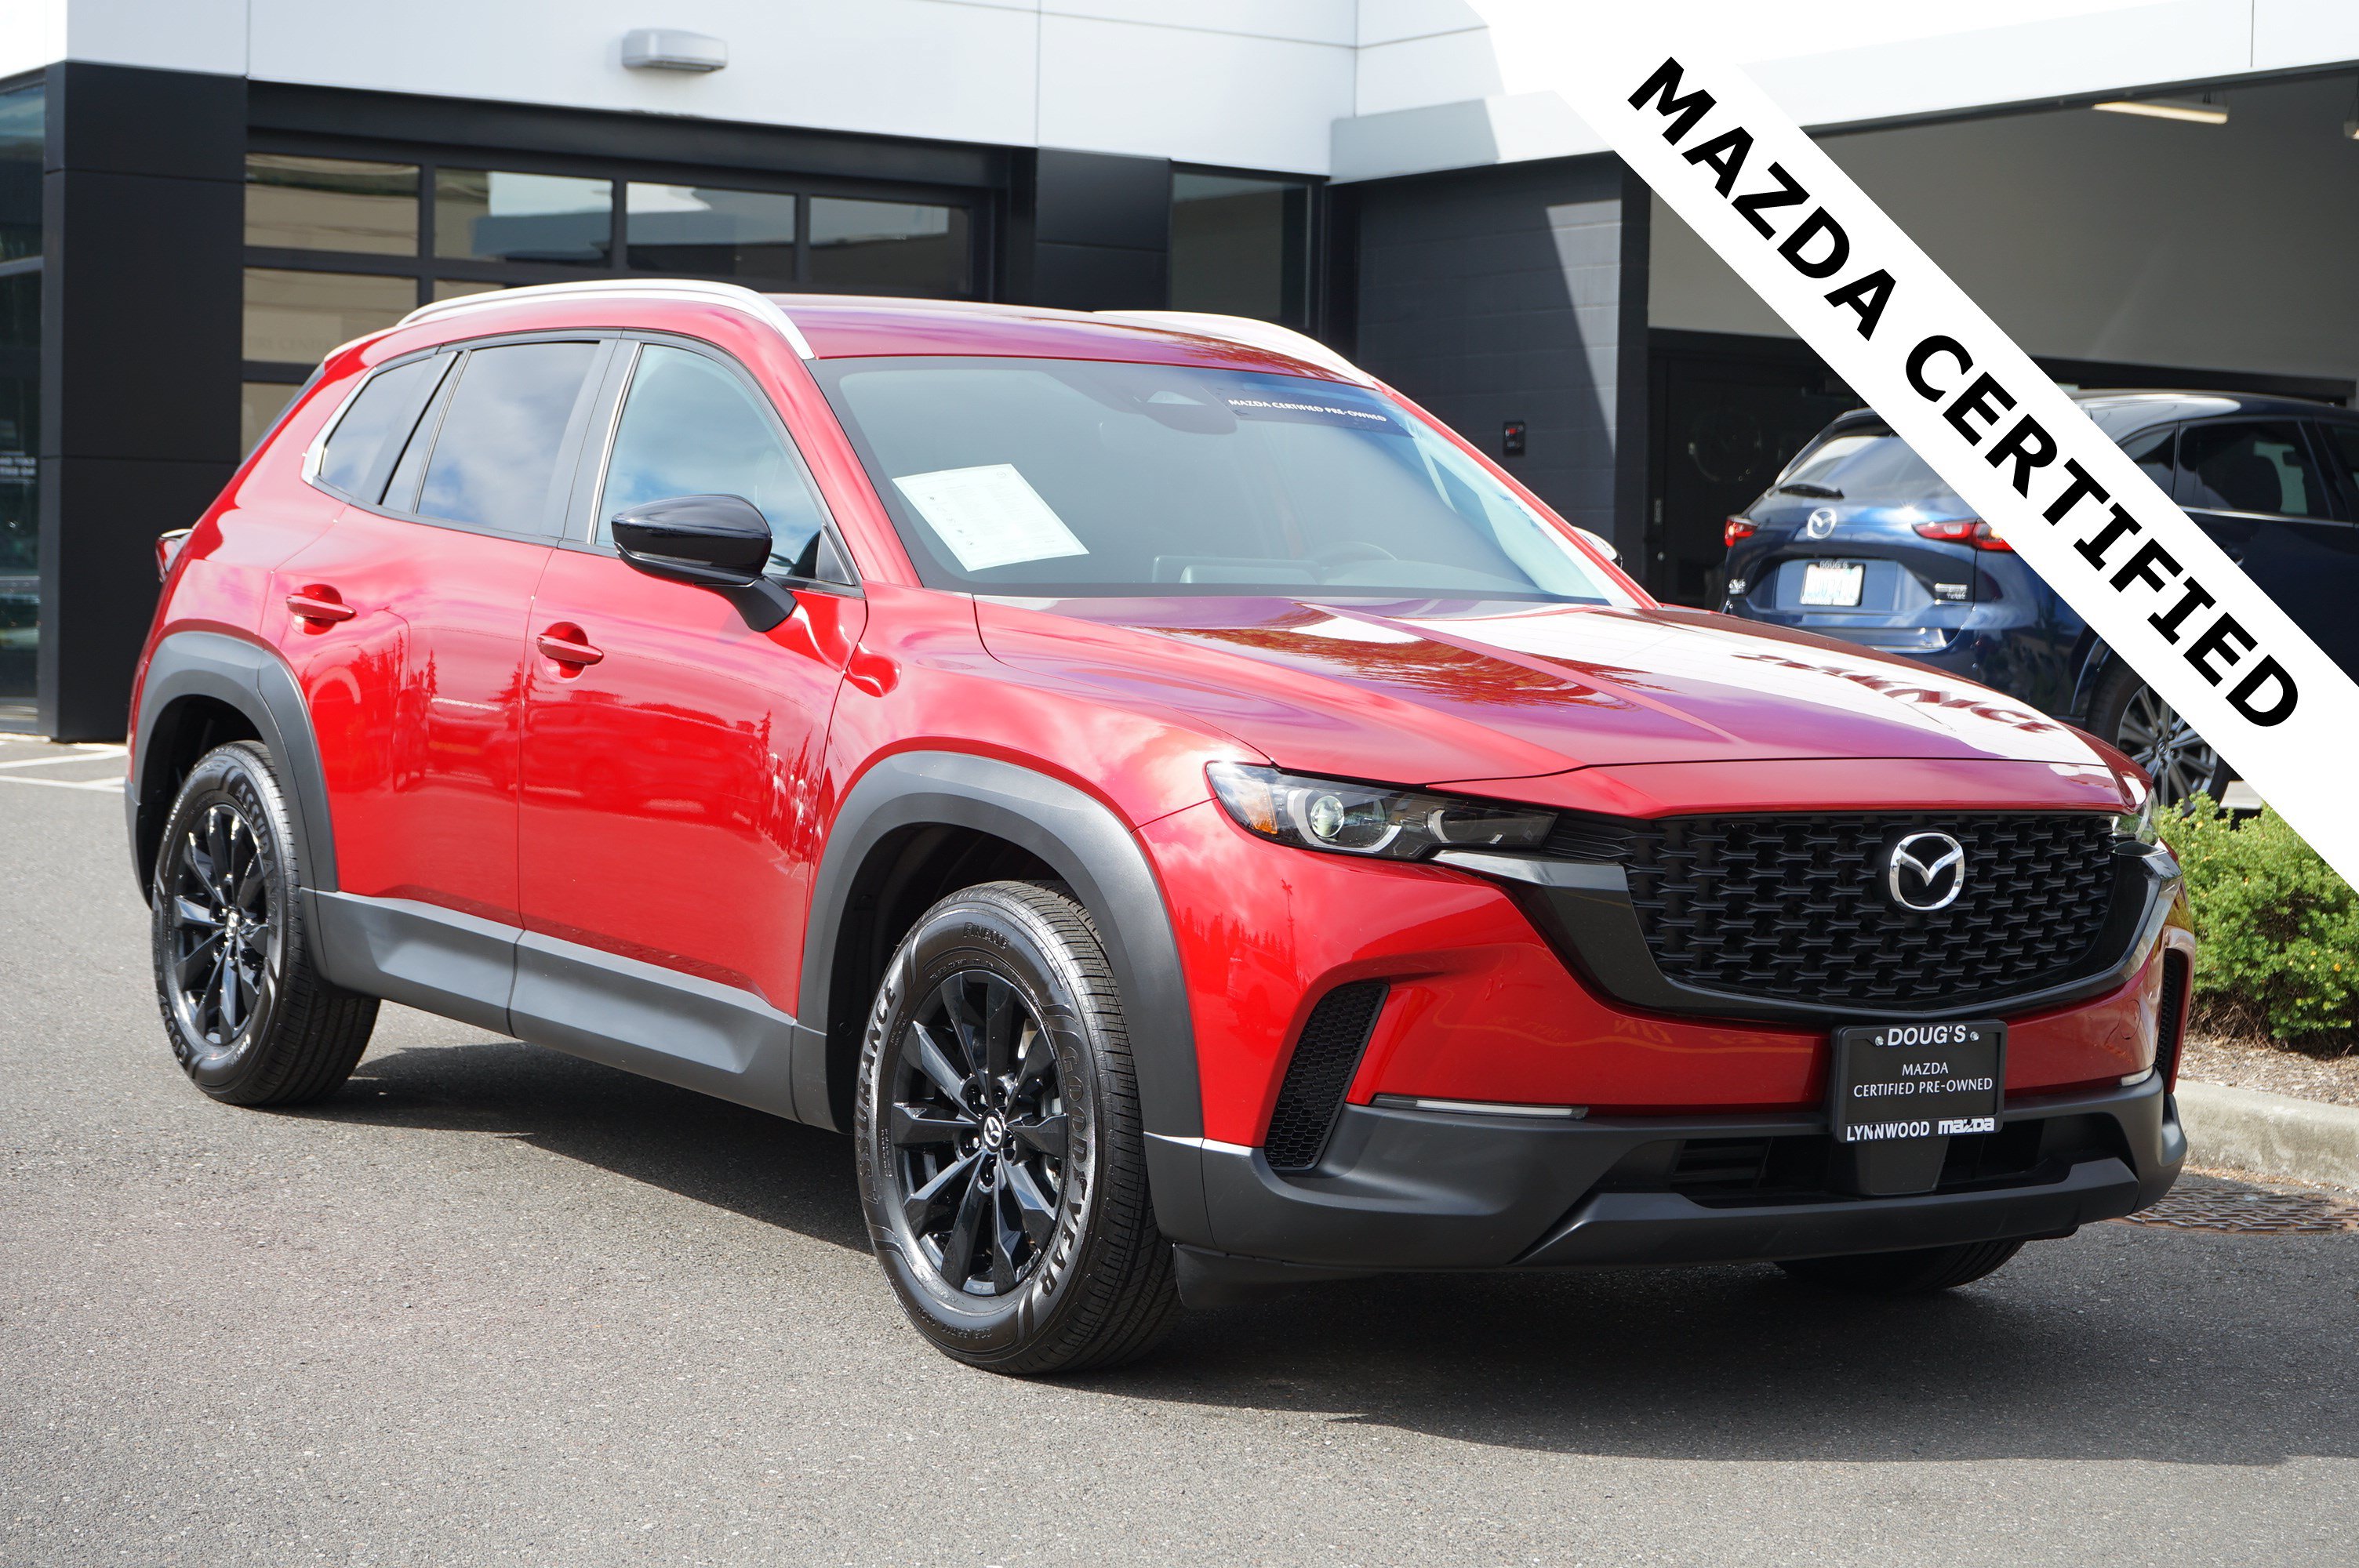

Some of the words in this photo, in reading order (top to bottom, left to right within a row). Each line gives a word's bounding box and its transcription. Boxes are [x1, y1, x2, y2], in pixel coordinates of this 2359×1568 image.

[1227, 398, 1271, 408] MAZDA
[1271, 401, 1324, 413] CERTIFIED
[1324, 406, 1387, 423] PRE-OWNED
[1887, 1025, 1967, 1047] DOUG'S
[1901, 1062, 1949, 1076] MAZDA
[854, 977, 896, 1205] ASSURANCE
[1853, 1082, 1915, 1098] CERTIFIED
[1918, 1077, 1994, 1094] PRE-OWNED
[1846, 1120, 1930, 1142] LYNNWOOD
[1038, 1045, 1088, 1298] GOODYEAR
